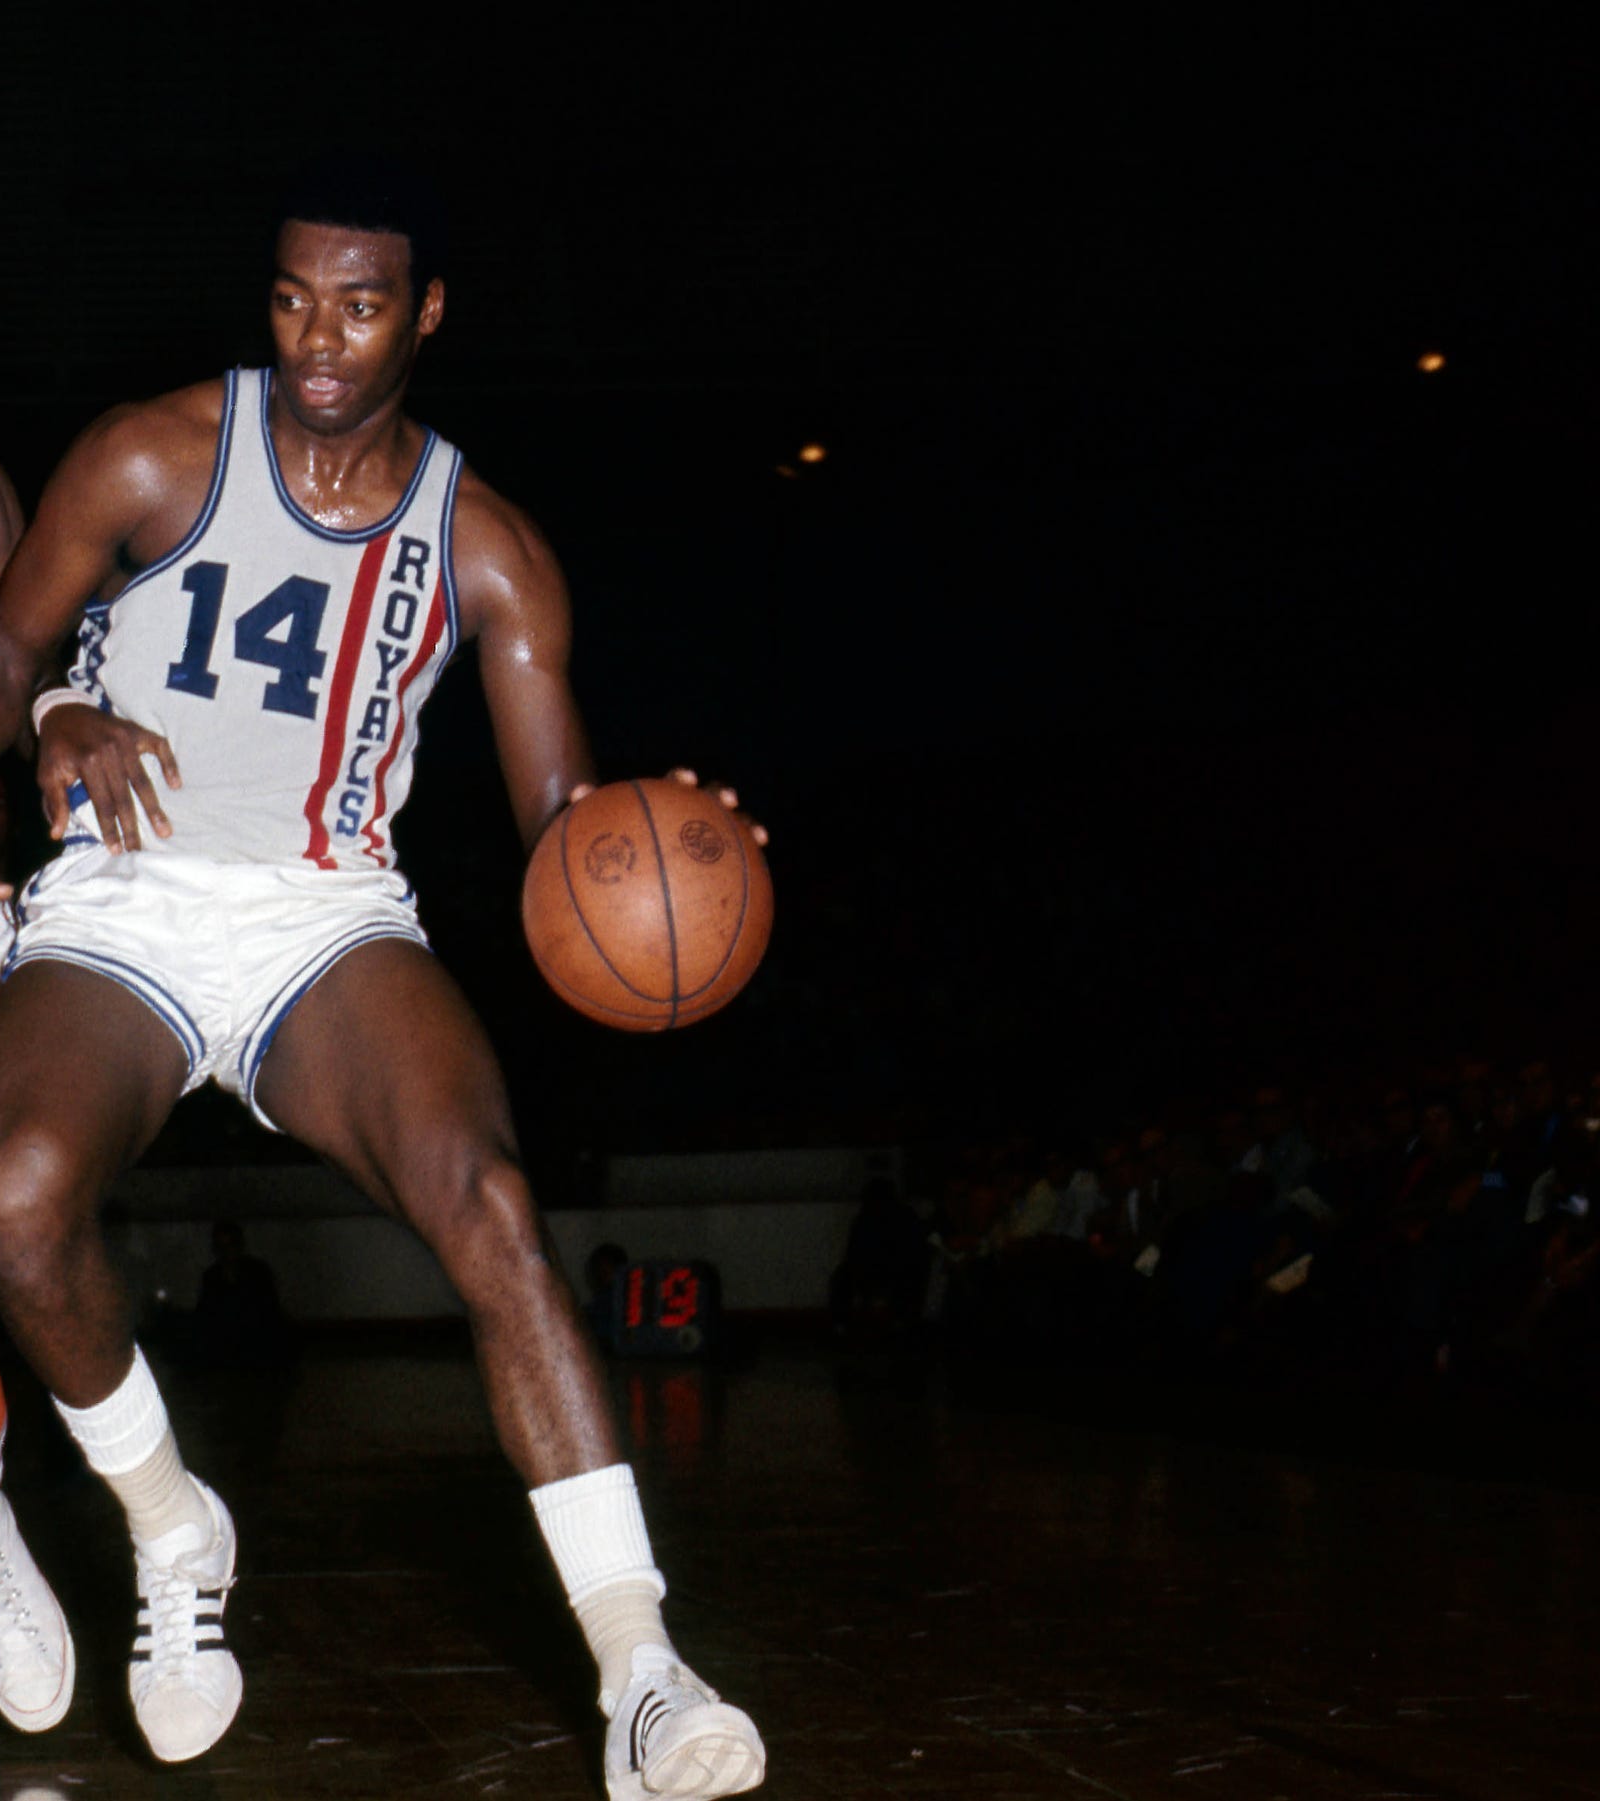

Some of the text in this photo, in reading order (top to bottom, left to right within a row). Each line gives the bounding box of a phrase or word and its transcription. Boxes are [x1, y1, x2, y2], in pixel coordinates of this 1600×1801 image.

[165, 560, 331, 721] 14
[336, 535, 431, 838] ROYALS
[626, 1267, 699, 1328] 19
